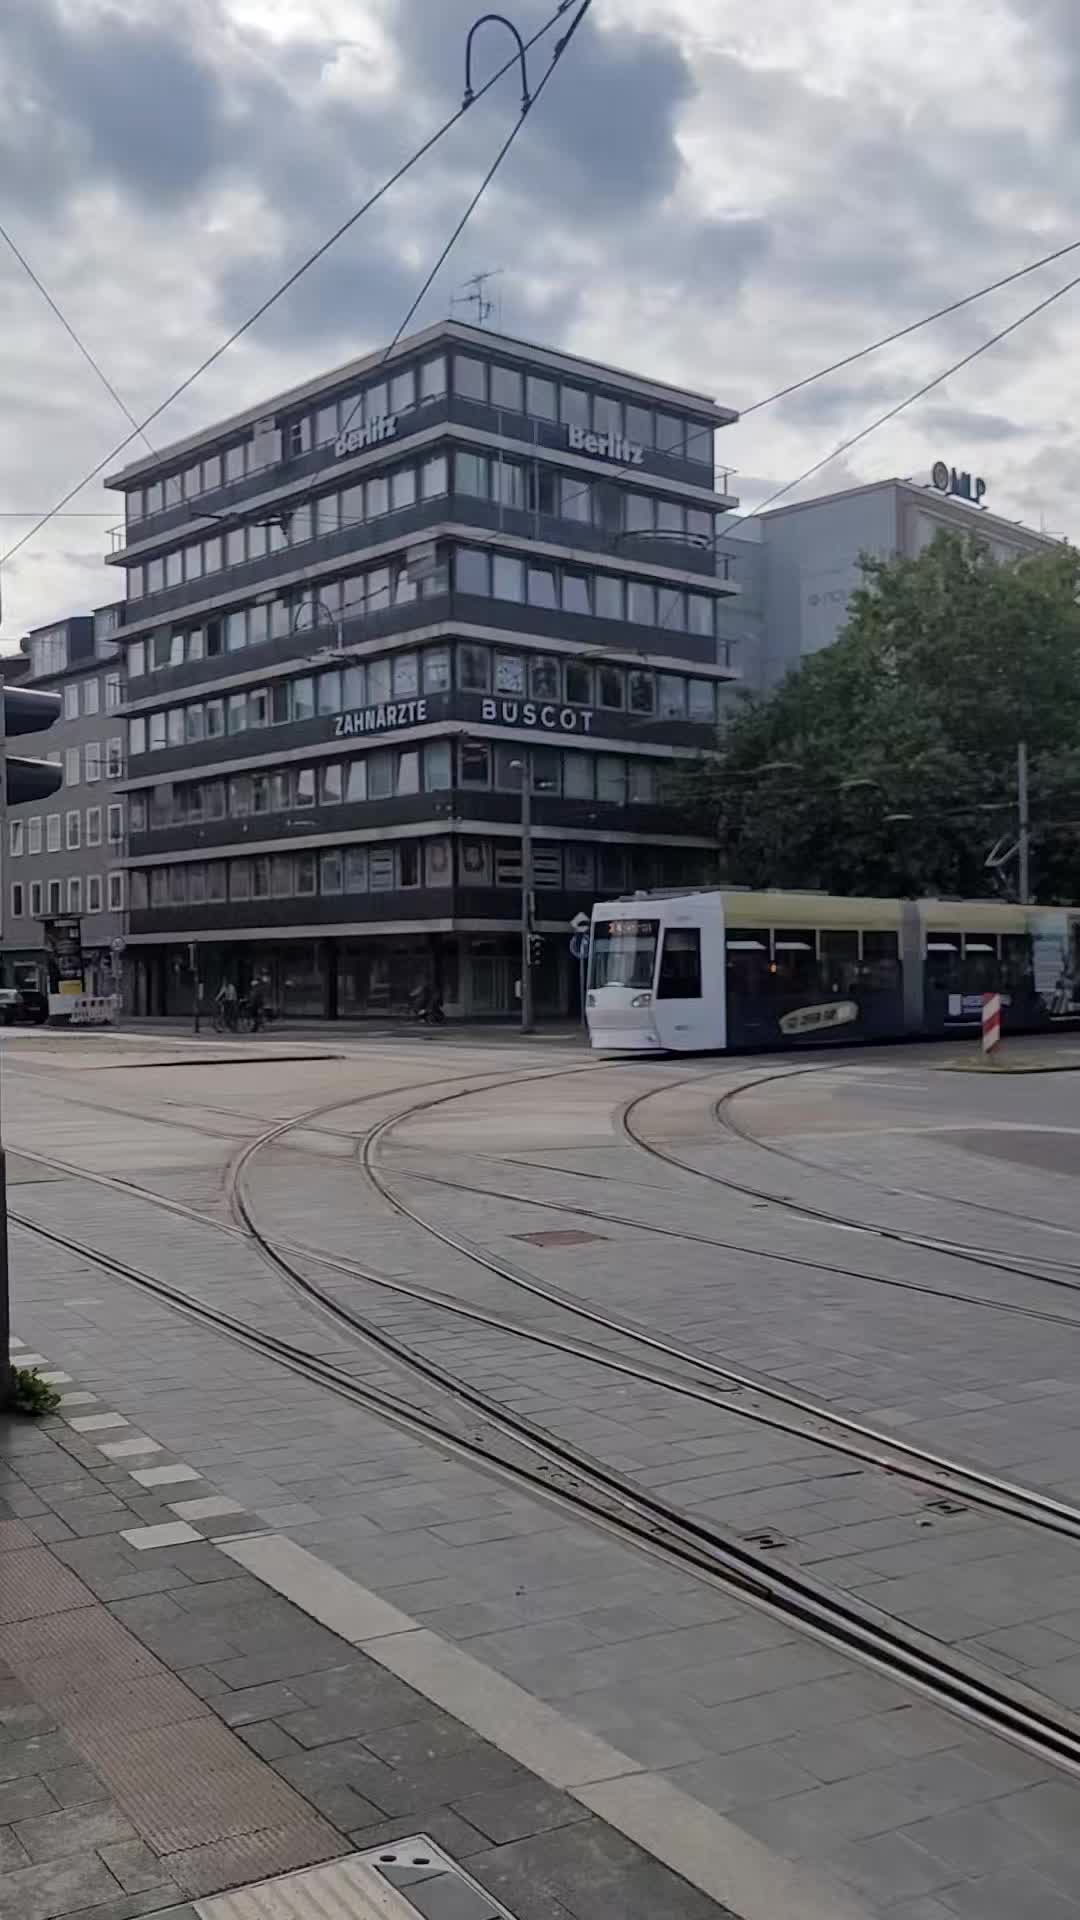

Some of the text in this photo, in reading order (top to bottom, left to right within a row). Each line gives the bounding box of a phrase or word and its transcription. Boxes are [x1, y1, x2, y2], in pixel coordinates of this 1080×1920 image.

[335, 414, 398, 457] Berlitz
[568, 424, 645, 464] Berlitz
[335, 699, 427, 736] ZAHNÄRZTE
